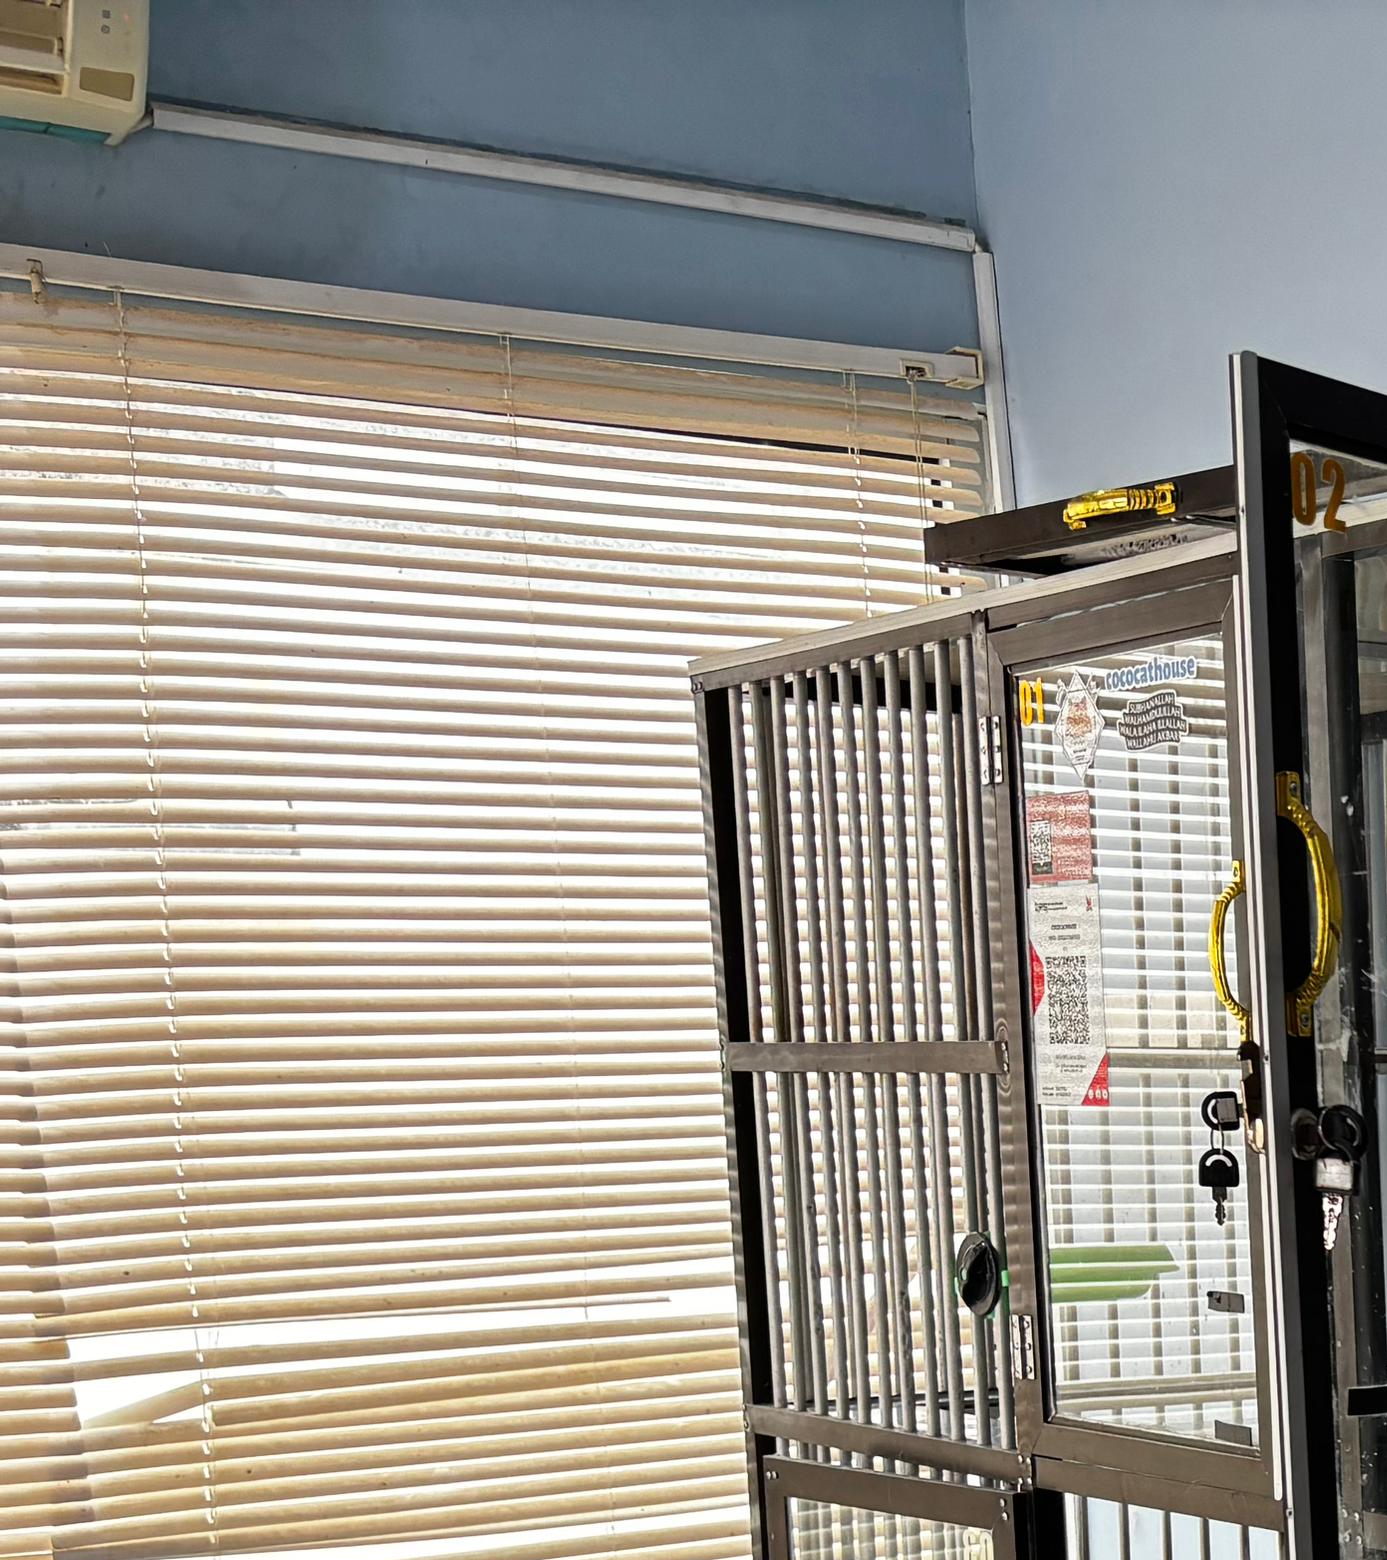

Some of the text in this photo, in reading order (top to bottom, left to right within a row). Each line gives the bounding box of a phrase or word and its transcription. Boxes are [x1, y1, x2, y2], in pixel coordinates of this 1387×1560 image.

[1291, 452, 1346, 532] 02
[1105, 656, 1195, 690] cococathouse
[1019, 677, 1044, 726] 01
